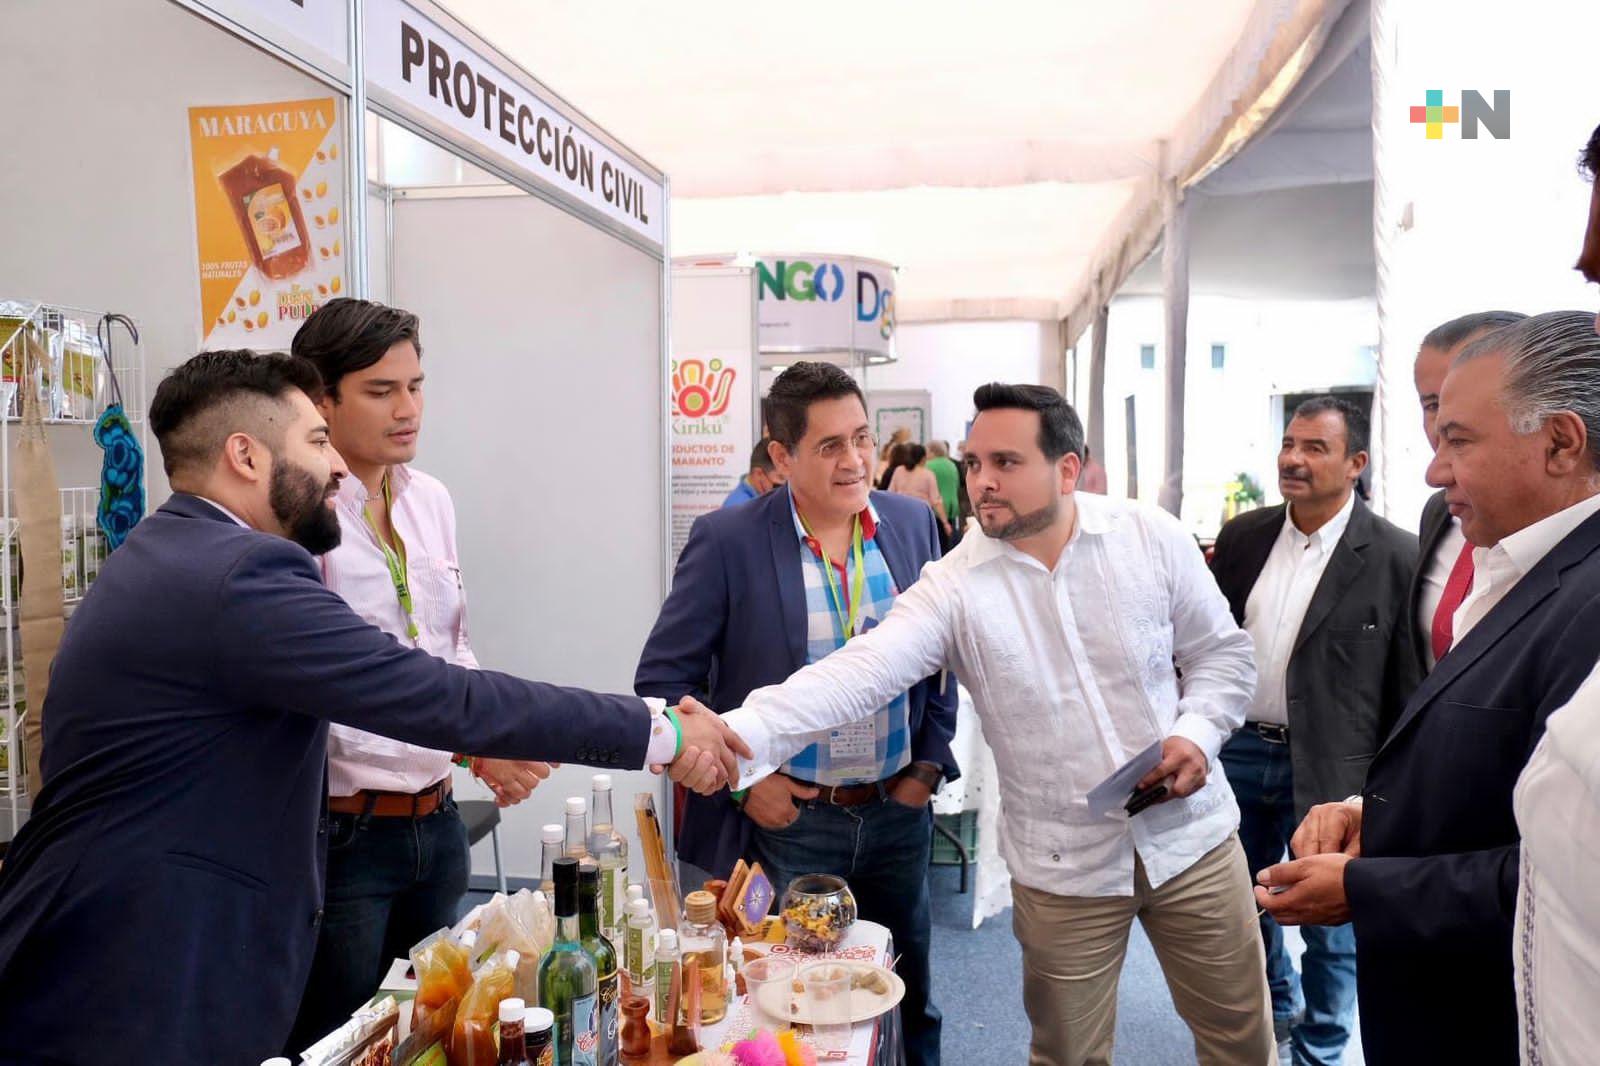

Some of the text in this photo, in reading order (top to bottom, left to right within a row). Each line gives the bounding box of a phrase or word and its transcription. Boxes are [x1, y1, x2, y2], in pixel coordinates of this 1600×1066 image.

[199, 108, 327, 137] MARACUYA
[401, 20, 649, 225] PROTECCIÓN CIVIL
[756, 261, 845, 302] NGO
[672, 456, 725, 466] MARANTO
